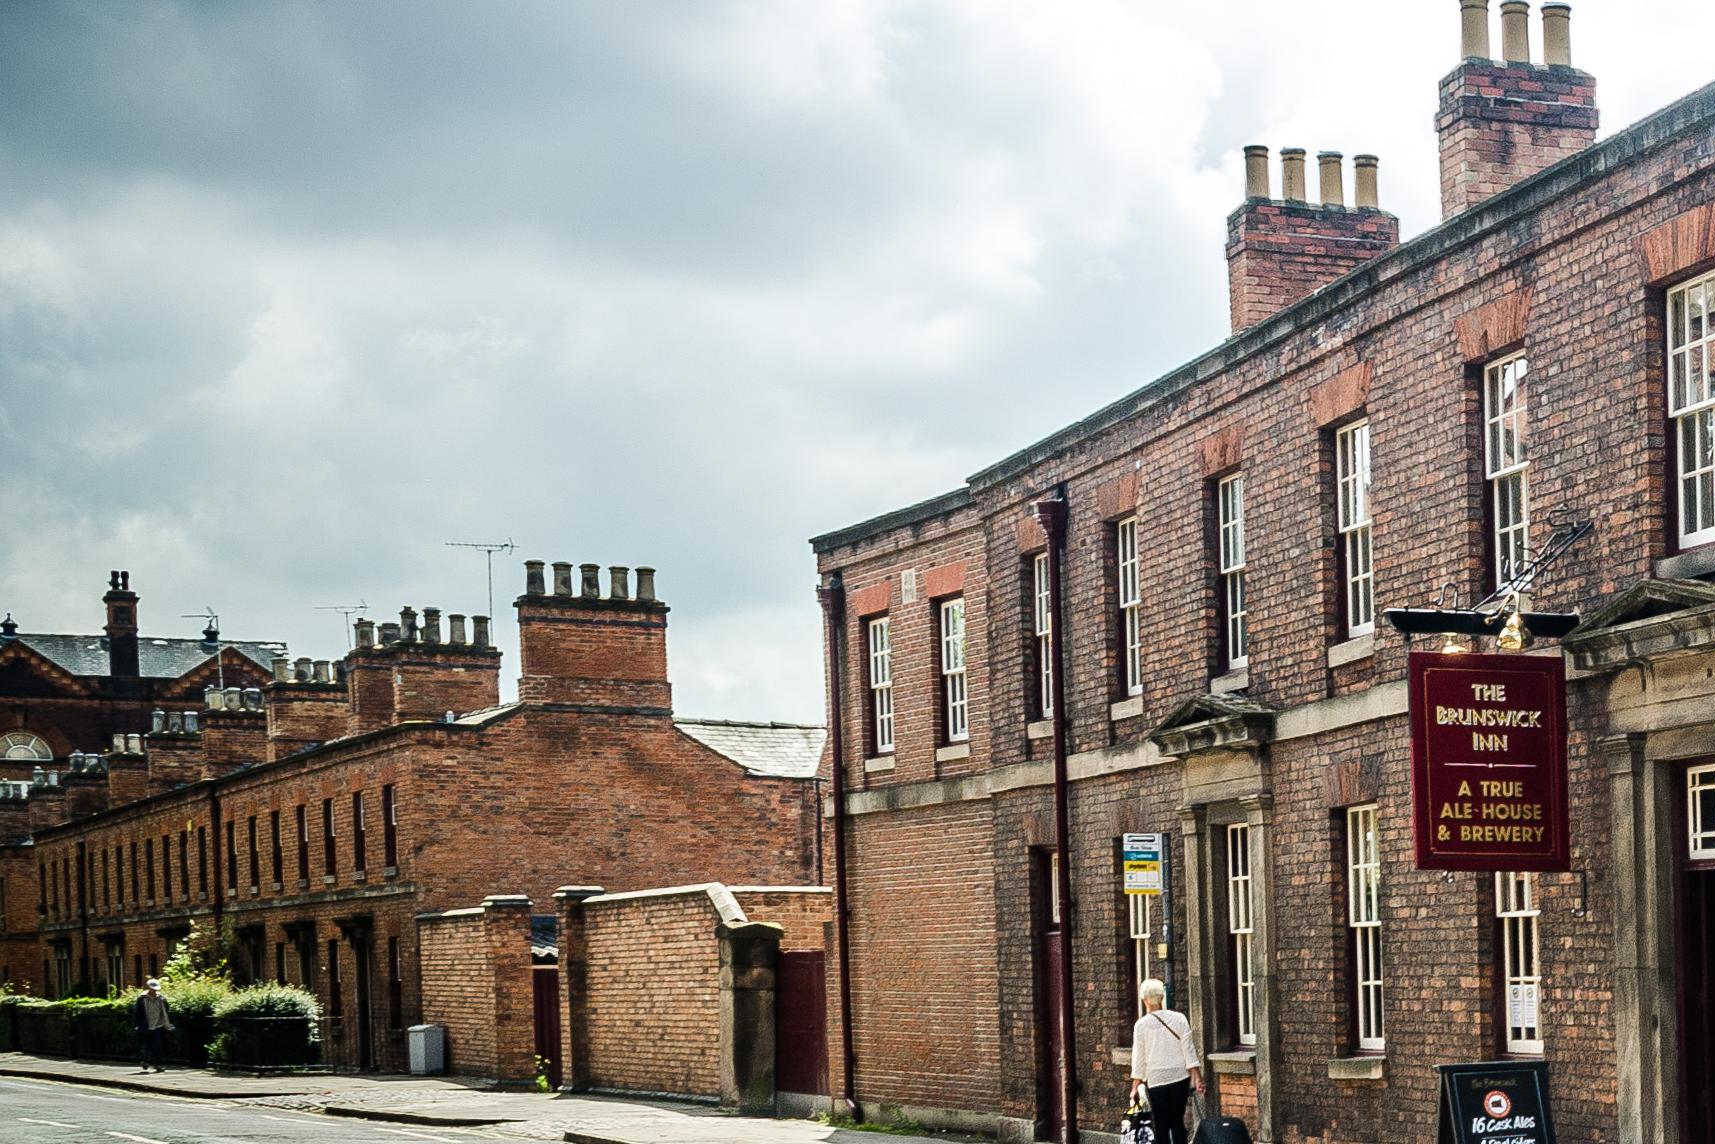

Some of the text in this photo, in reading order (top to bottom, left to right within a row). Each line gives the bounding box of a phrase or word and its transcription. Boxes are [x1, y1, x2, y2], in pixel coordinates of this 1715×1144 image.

[1470, 683, 1506, 702] THE
[1436, 705, 1542, 728] BRUNSWICK
[1472, 732, 1508, 752] INN
[1458, 780, 1524, 798] A TRUE
[1437, 824, 1545, 843] & BREWERY
[1472, 1115, 1536, 1134] 16 Cask Ales
